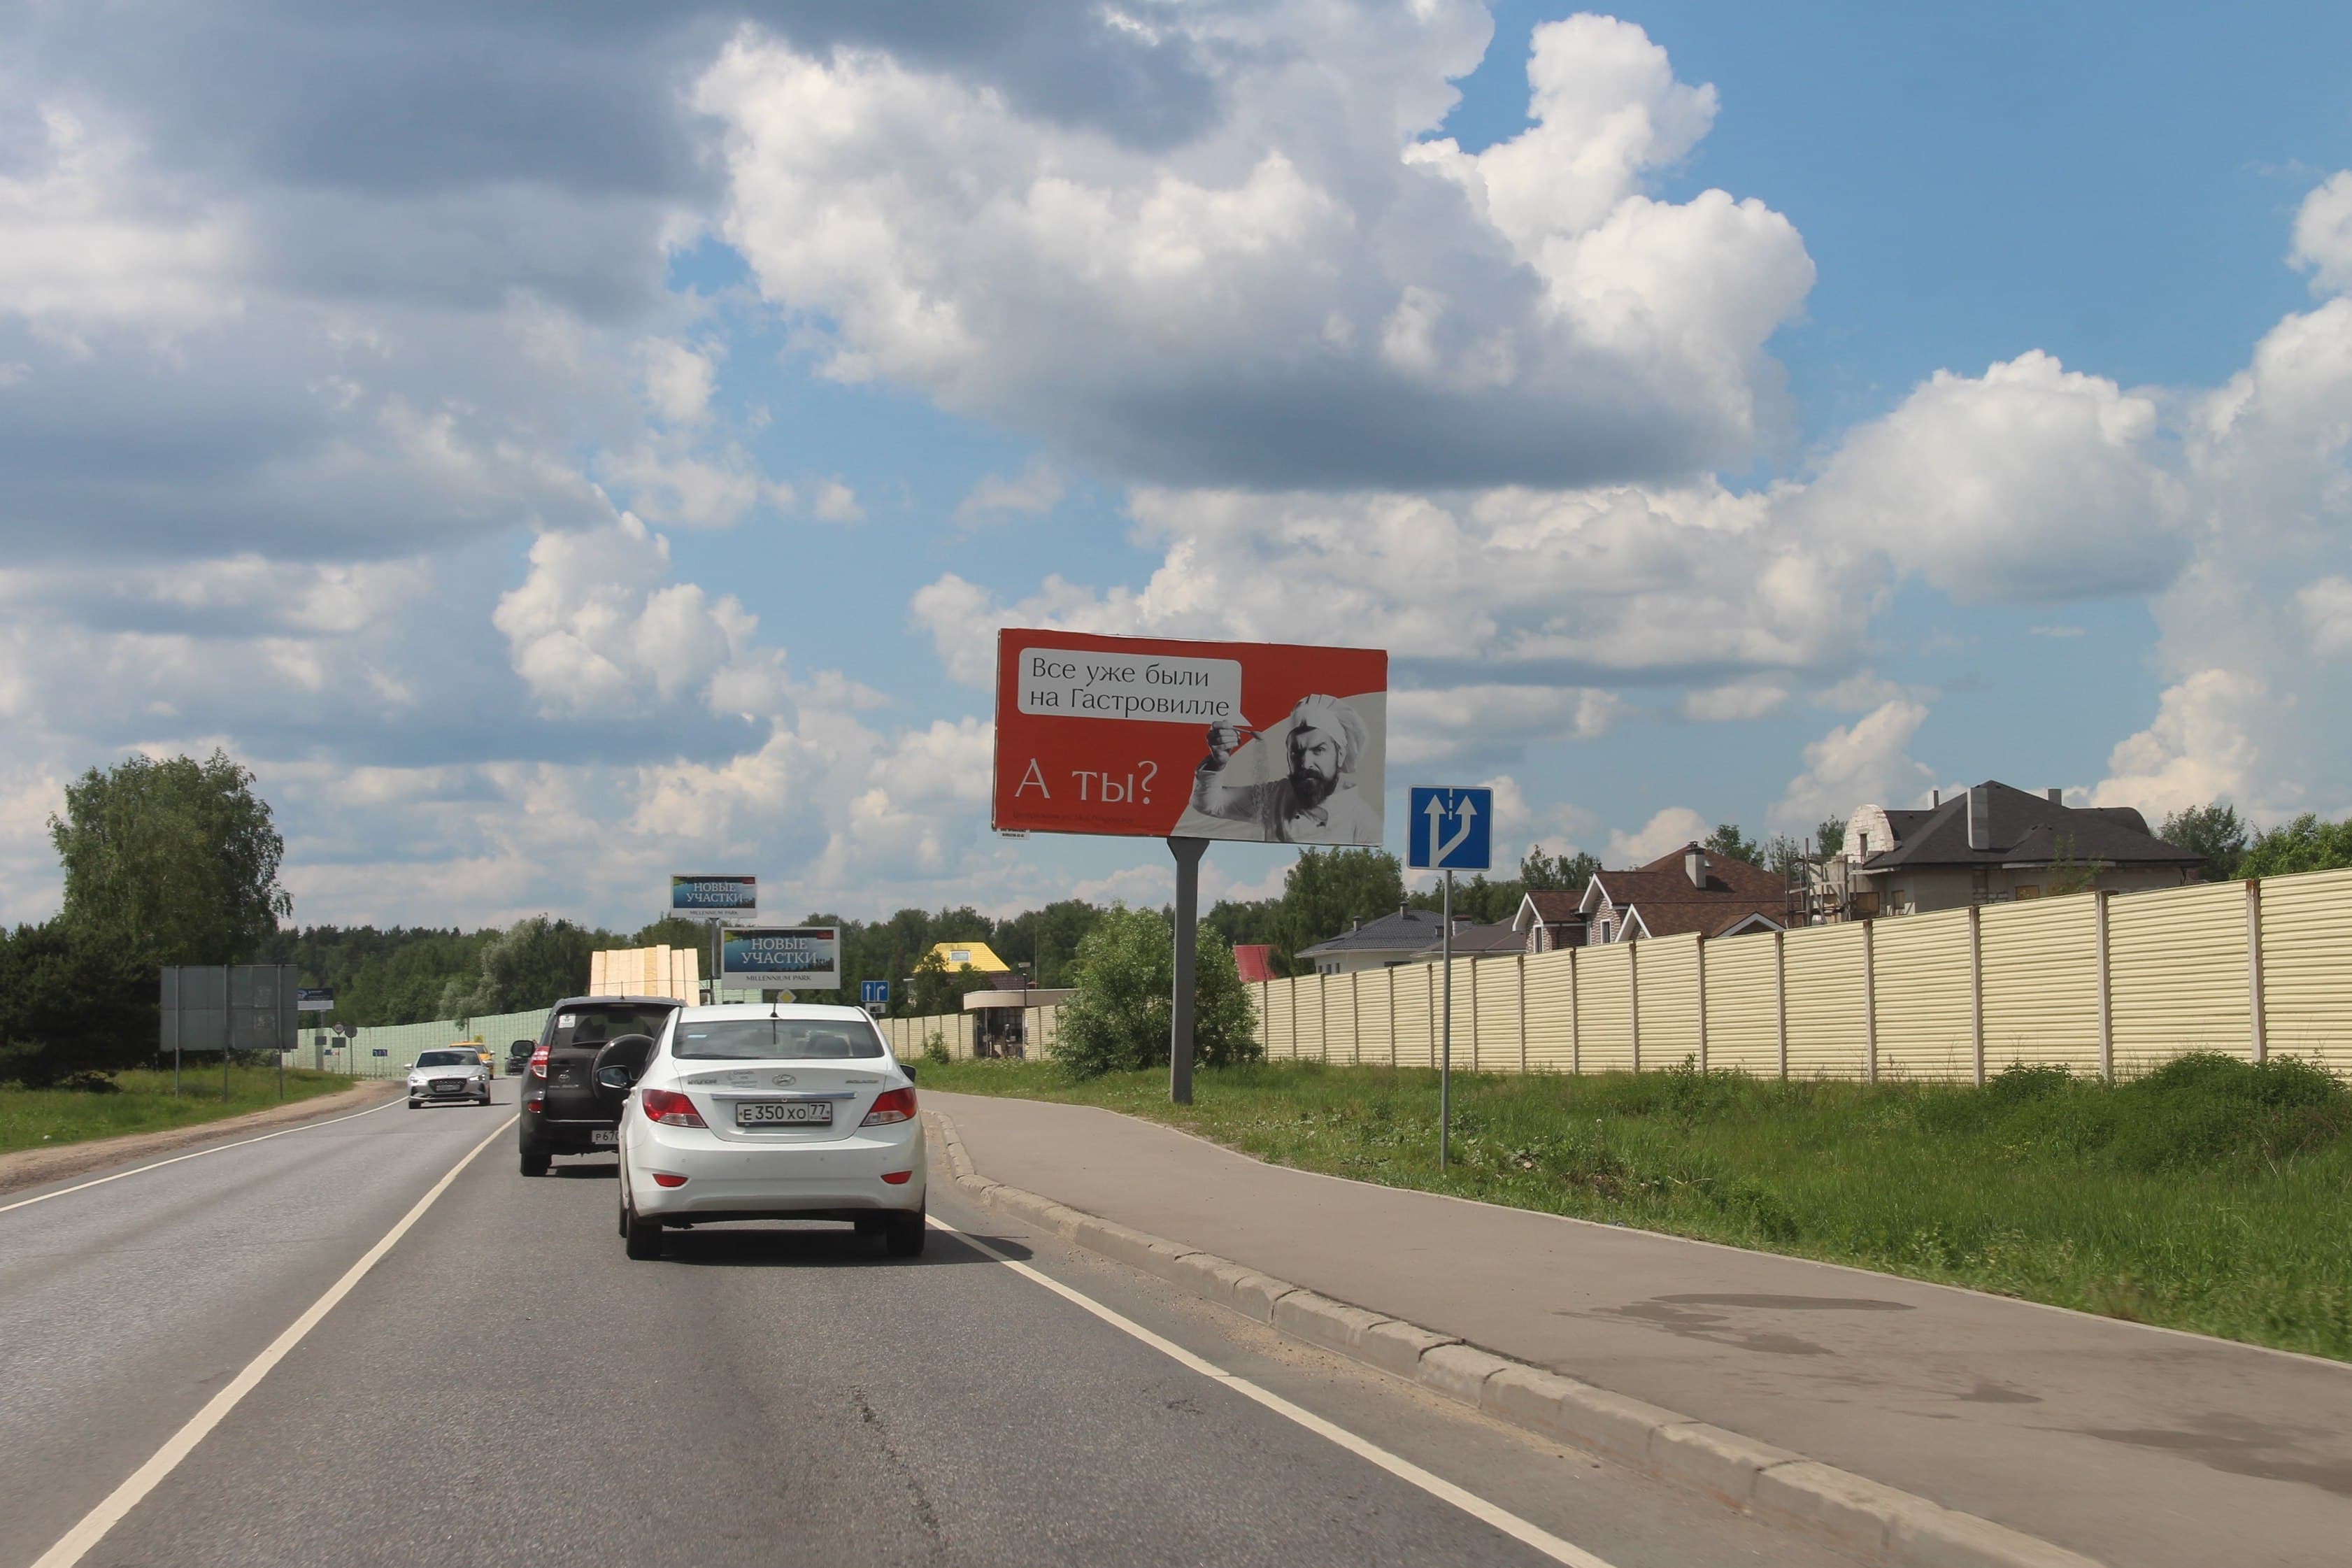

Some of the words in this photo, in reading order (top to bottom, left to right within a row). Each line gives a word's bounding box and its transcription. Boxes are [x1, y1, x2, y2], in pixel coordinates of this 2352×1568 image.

[1032, 657, 1076, 679] Все
[1085, 665, 1136, 687] уже
[1146, 662, 1209, 687] были
[1030, 690, 1060, 707] на
[1071, 688, 1230, 719] Гастровилле
[1015, 757, 1050, 799] А
[1071, 760, 1157, 804] ты?
[694, 883, 735, 892] НОВЫЕ
[687, 893, 743, 902] УЧАСТКИ
[751, 939, 808, 950] НОВЫЕ
[741, 952, 817, 964] УЧАСТКИ
[811, 1104, 825, 1116] 77
